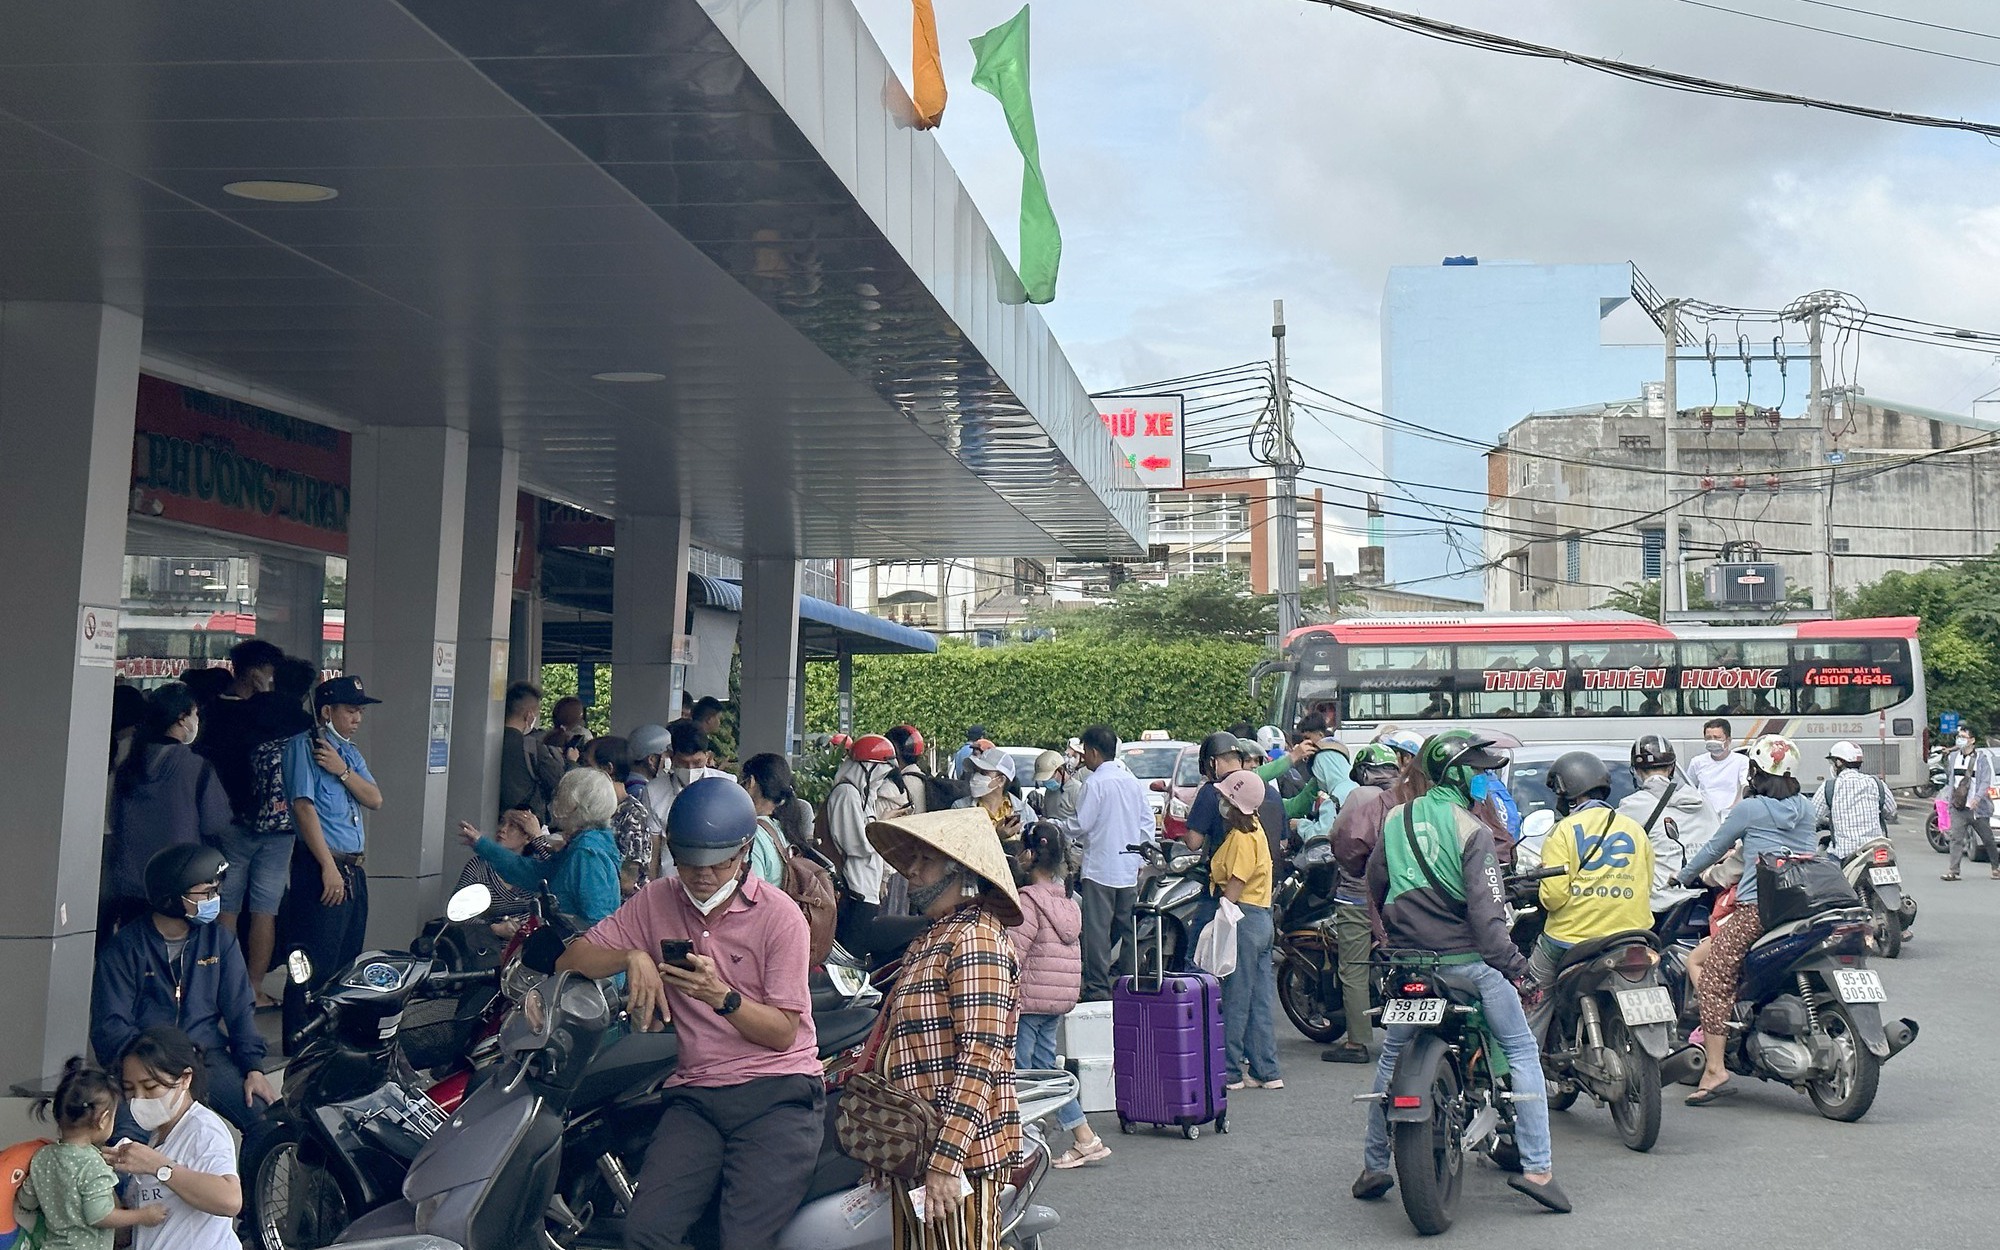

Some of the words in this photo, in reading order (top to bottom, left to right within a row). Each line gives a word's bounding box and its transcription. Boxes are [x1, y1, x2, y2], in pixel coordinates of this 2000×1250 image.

[1144, 412, 1174, 437] XE
[1483, 666, 1567, 690] THIÊN
[1582, 665, 1667, 690] THIÊN
[1680, 666, 1782, 689] HƯƠNG
[1813, 674, 1849, 685] 1900
[1852, 674, 1892, 685] 4646
[1572, 823, 1636, 872] be
[1484, 867, 1502, 904] gojek
